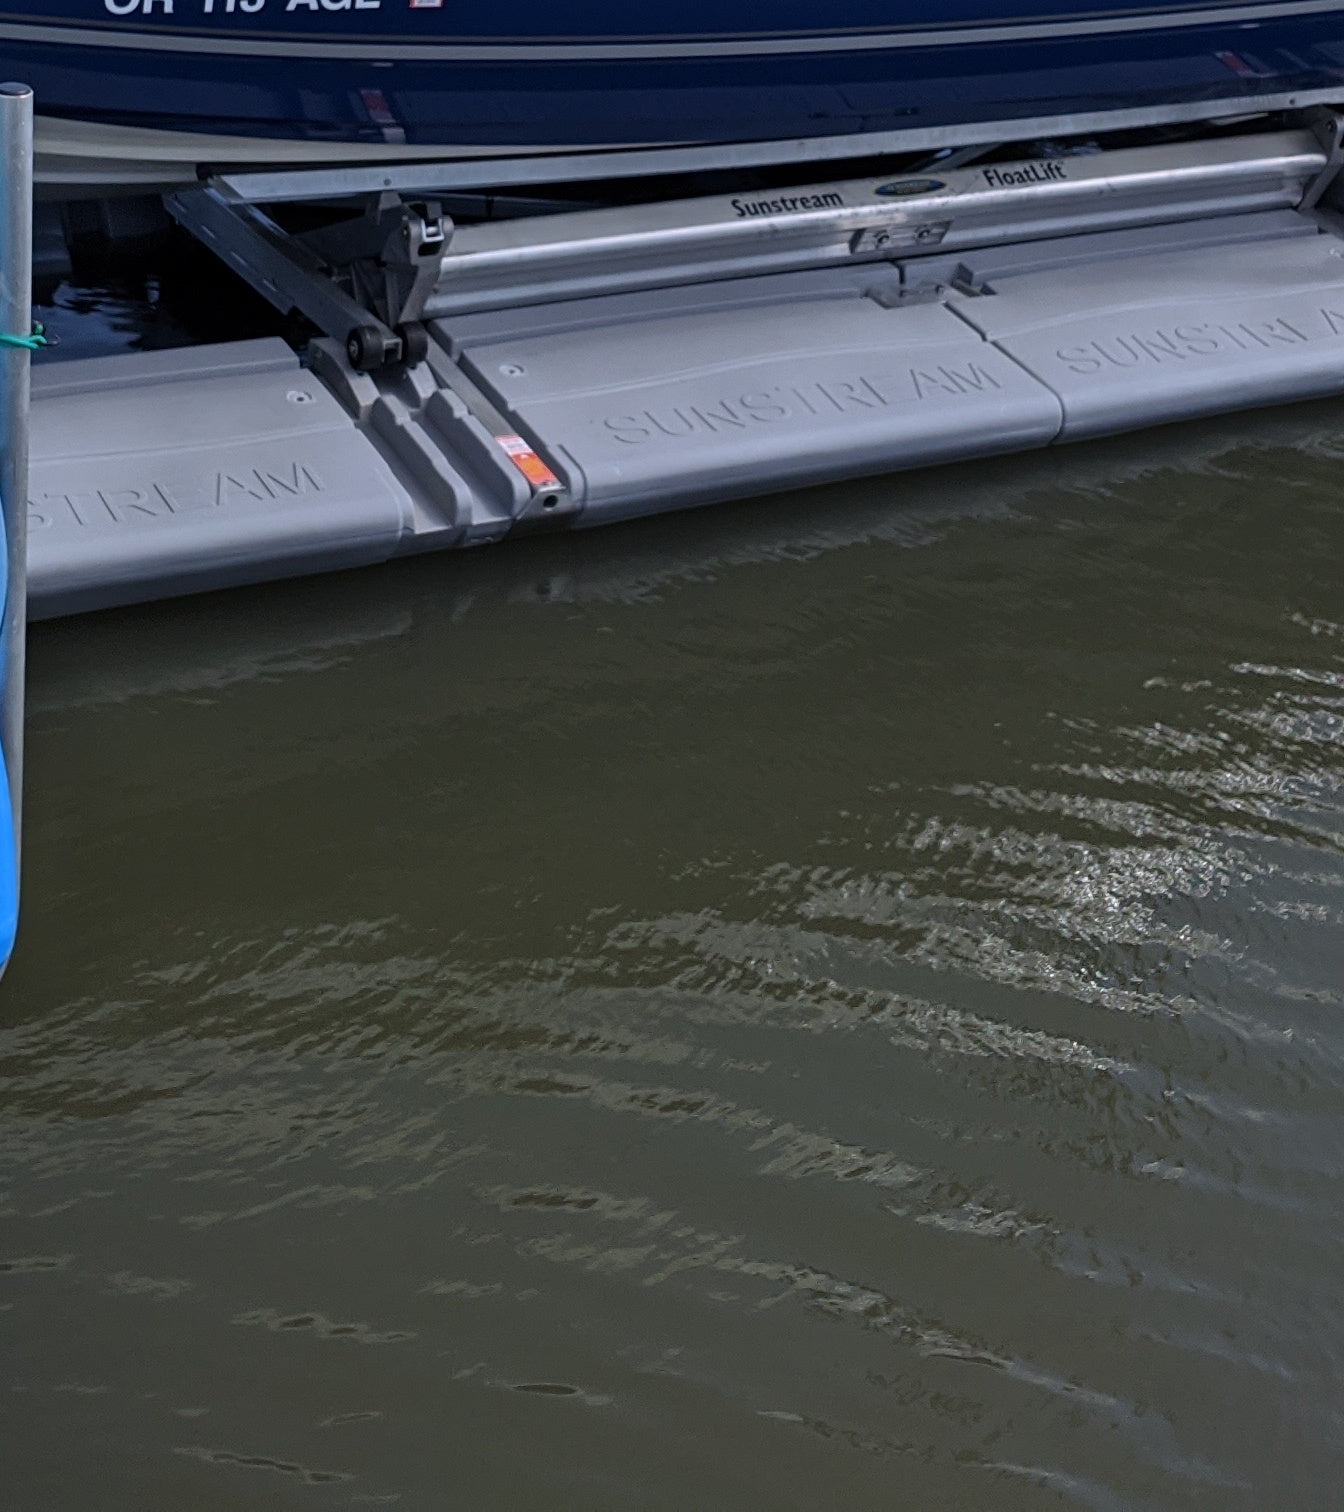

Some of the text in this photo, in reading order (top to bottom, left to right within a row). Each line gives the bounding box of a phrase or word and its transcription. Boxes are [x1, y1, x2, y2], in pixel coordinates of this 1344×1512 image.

[982, 162, 1067, 187] FloatLift
[730, 191, 844, 218] Sunstream
[603, 362, 1001, 445] SUNSTREAM
